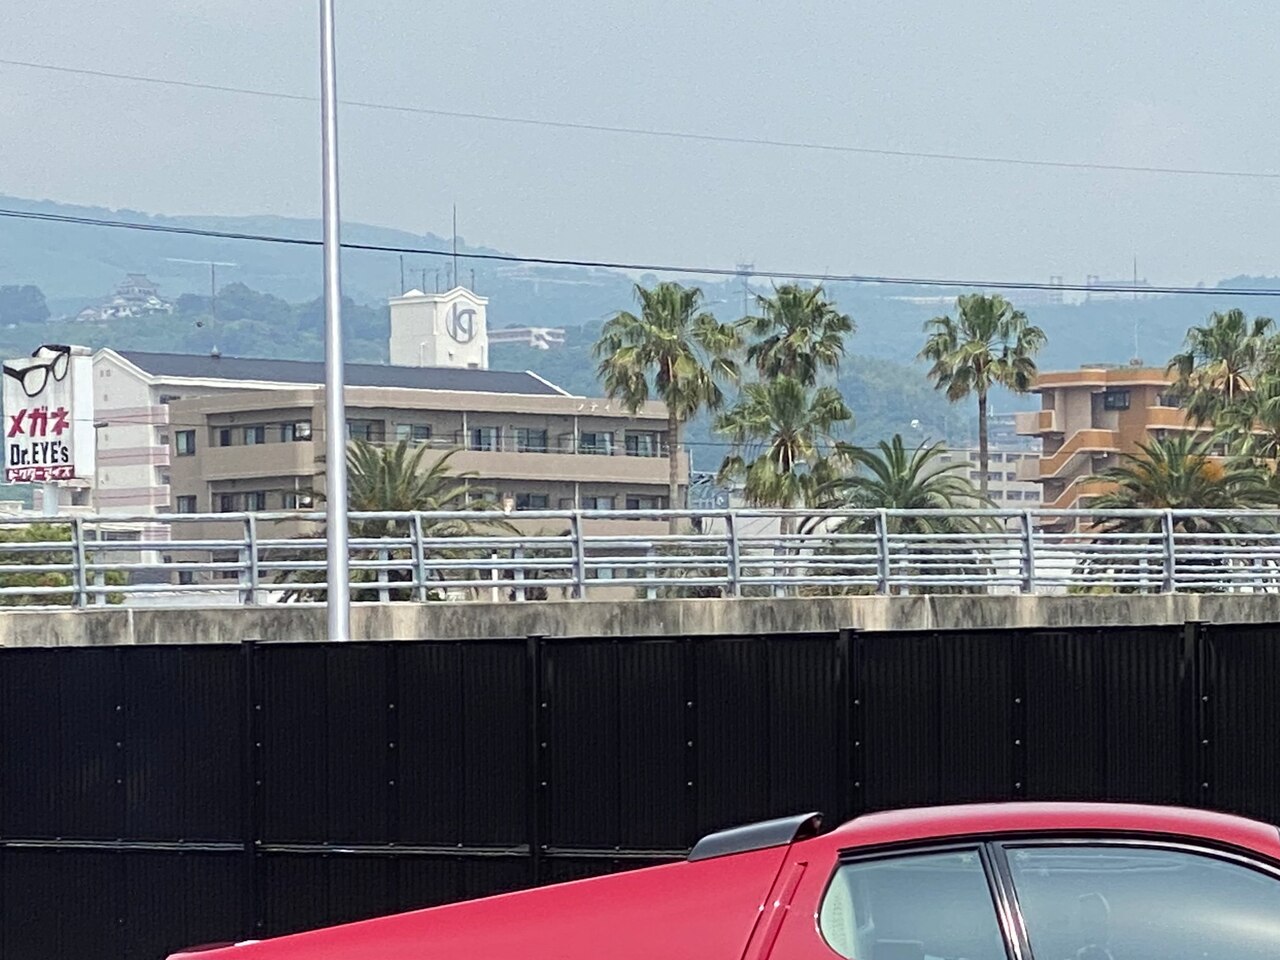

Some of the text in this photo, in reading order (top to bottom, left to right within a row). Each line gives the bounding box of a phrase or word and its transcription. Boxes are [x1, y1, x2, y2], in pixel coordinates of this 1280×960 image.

[7, 405, 70, 438] メガネ
[10, 440, 69, 466] Dr.EYE's
